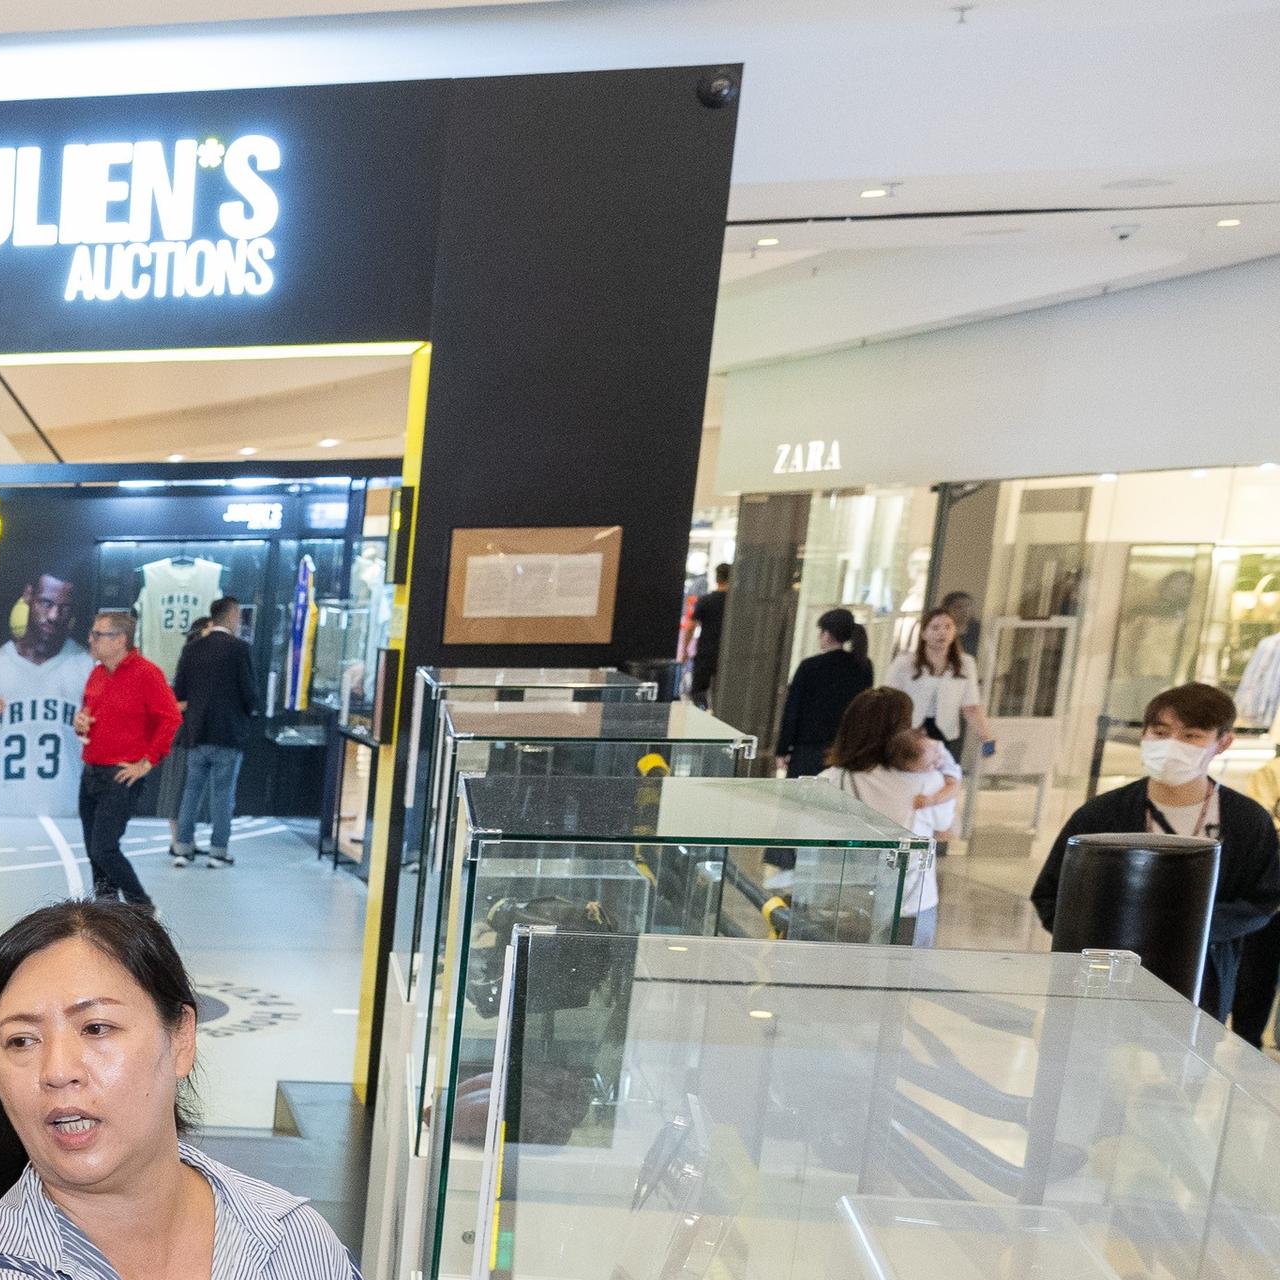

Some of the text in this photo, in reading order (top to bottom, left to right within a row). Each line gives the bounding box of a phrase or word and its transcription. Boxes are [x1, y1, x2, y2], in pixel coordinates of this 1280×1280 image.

[64, 237, 276, 300] AUCTIONS
[773, 439, 842, 474] ZARA
[163, 608, 191, 630] 23
[3, 733, 61, 780] 23
